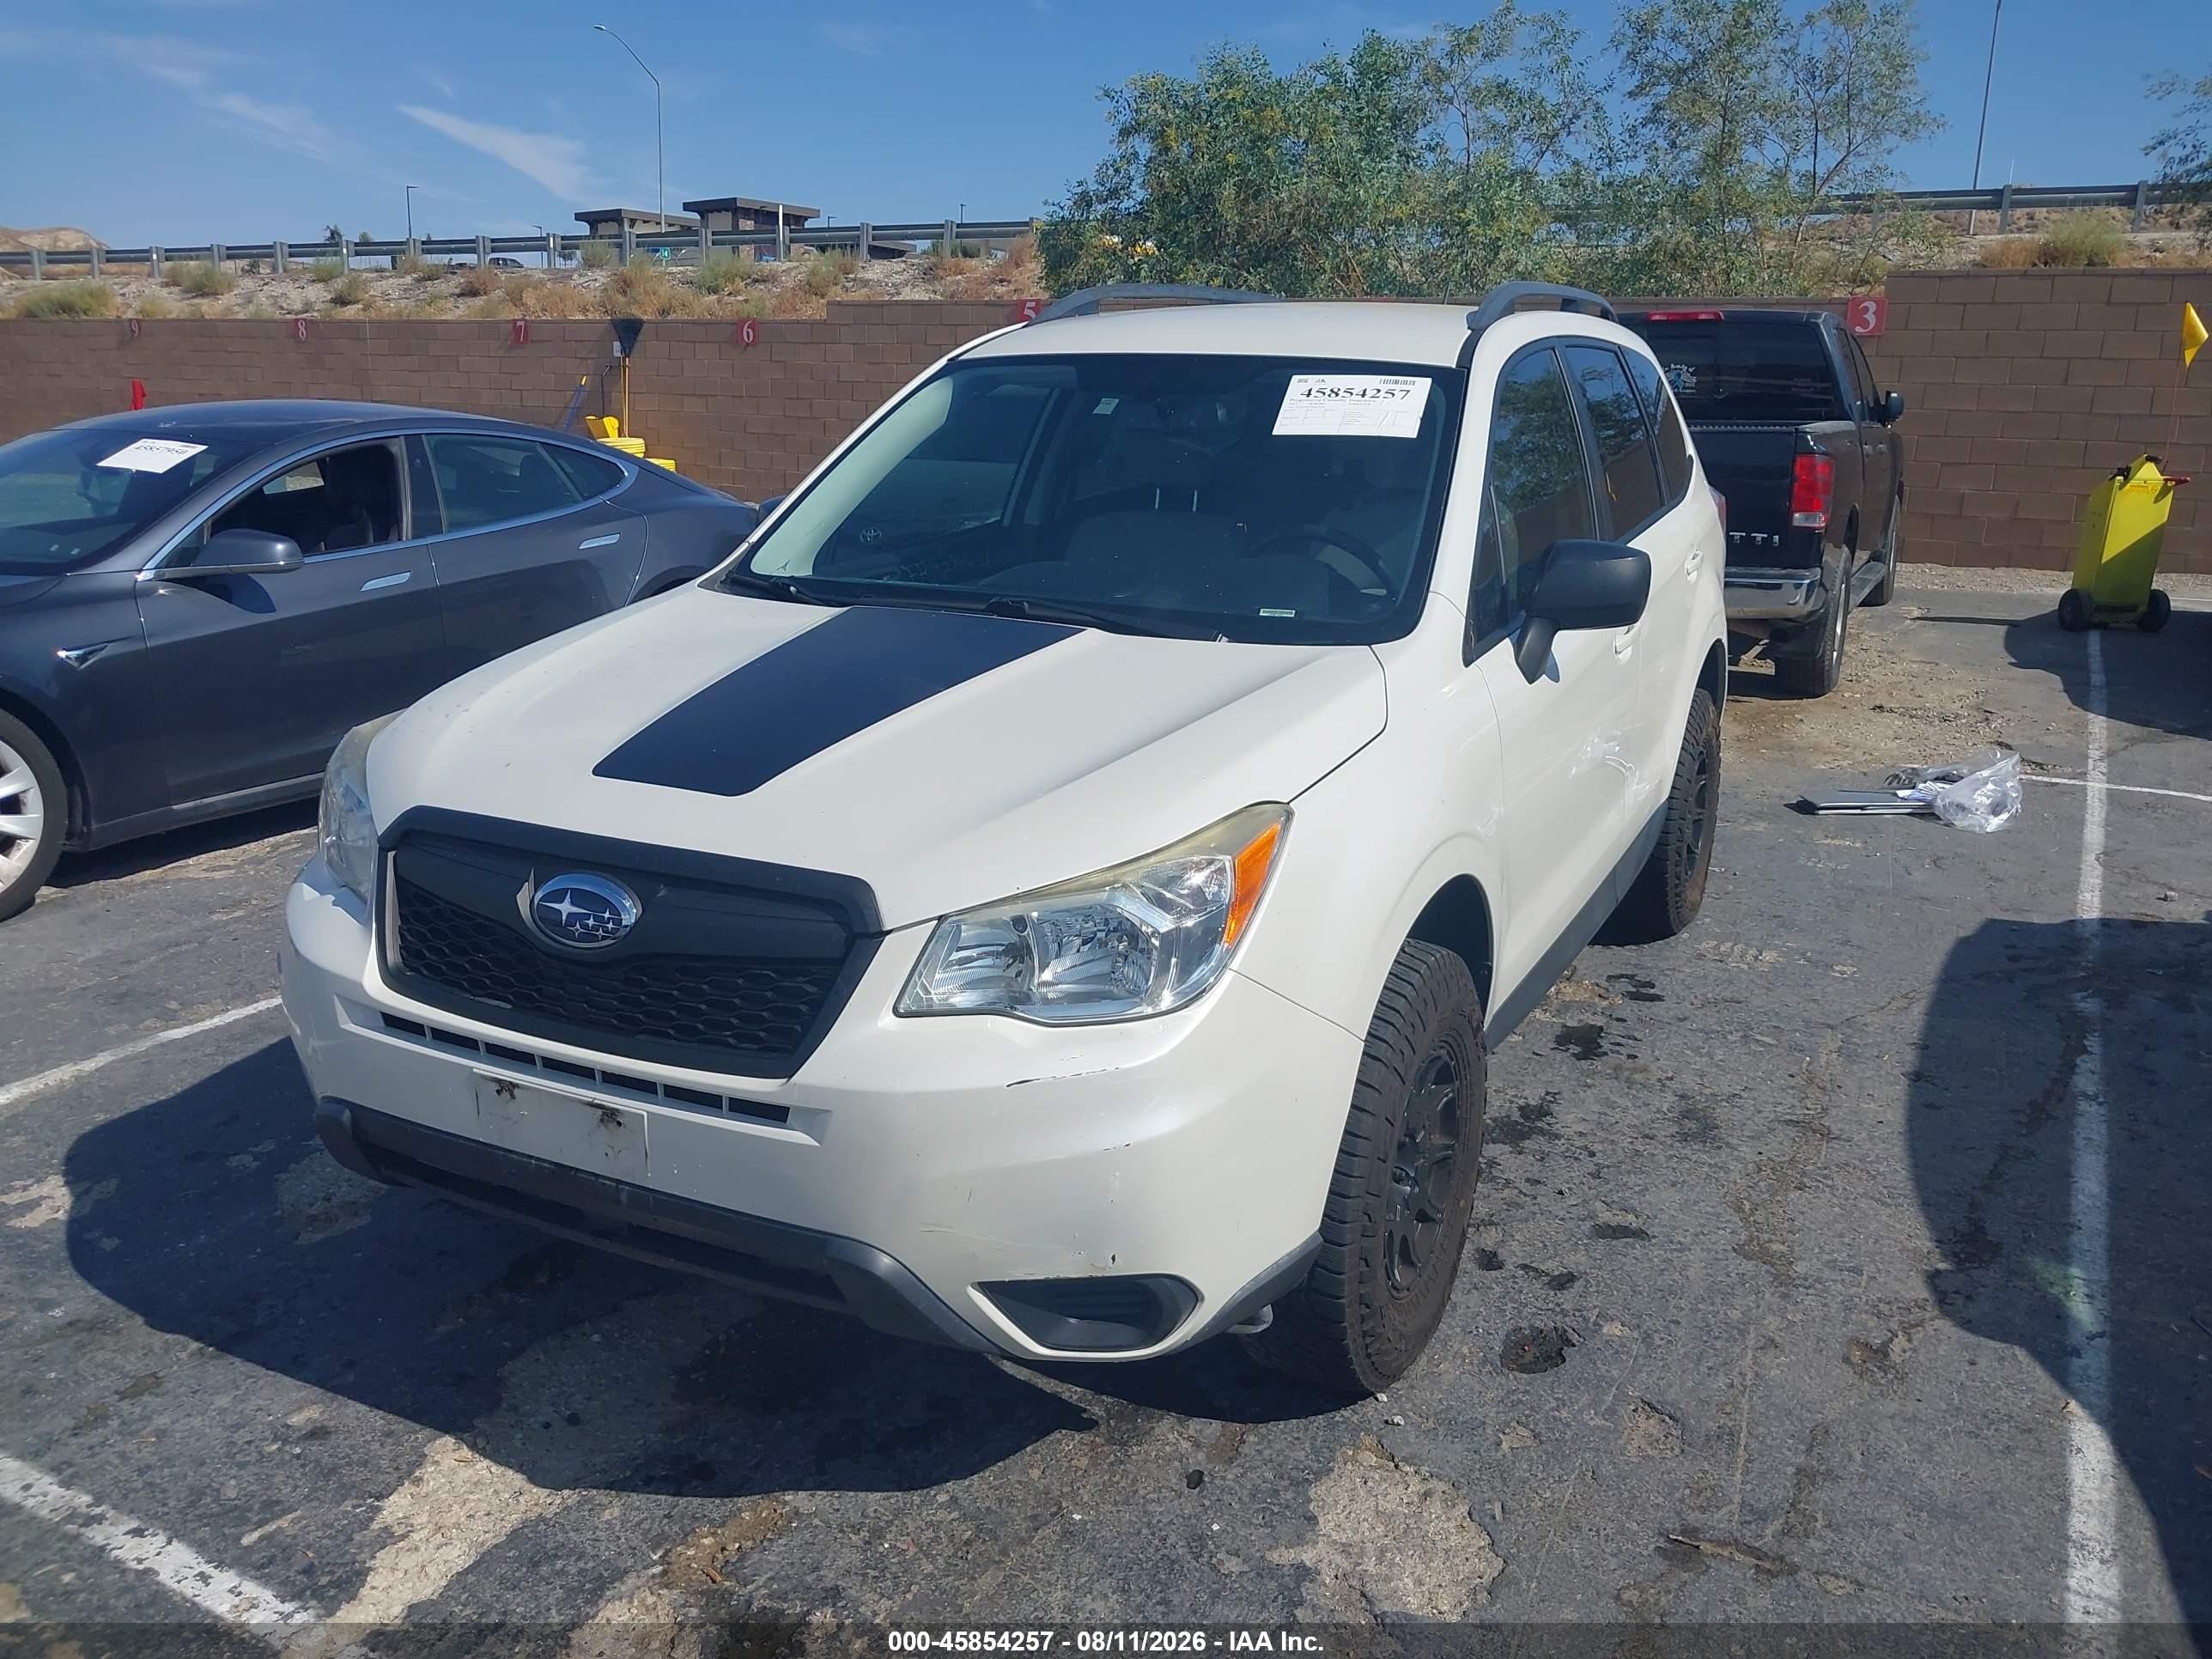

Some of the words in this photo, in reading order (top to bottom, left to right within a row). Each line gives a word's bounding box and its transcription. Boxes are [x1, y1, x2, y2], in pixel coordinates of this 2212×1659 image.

[1023, 301, 1036, 319] 5
[1855, 301, 1876, 332] 3
[131, 319, 139, 337] 9
[298, 319, 307, 338] 8
[516, 320, 525, 342] 7
[743, 319, 754, 343] 6
[1299, 386, 1412, 400] 45854257
